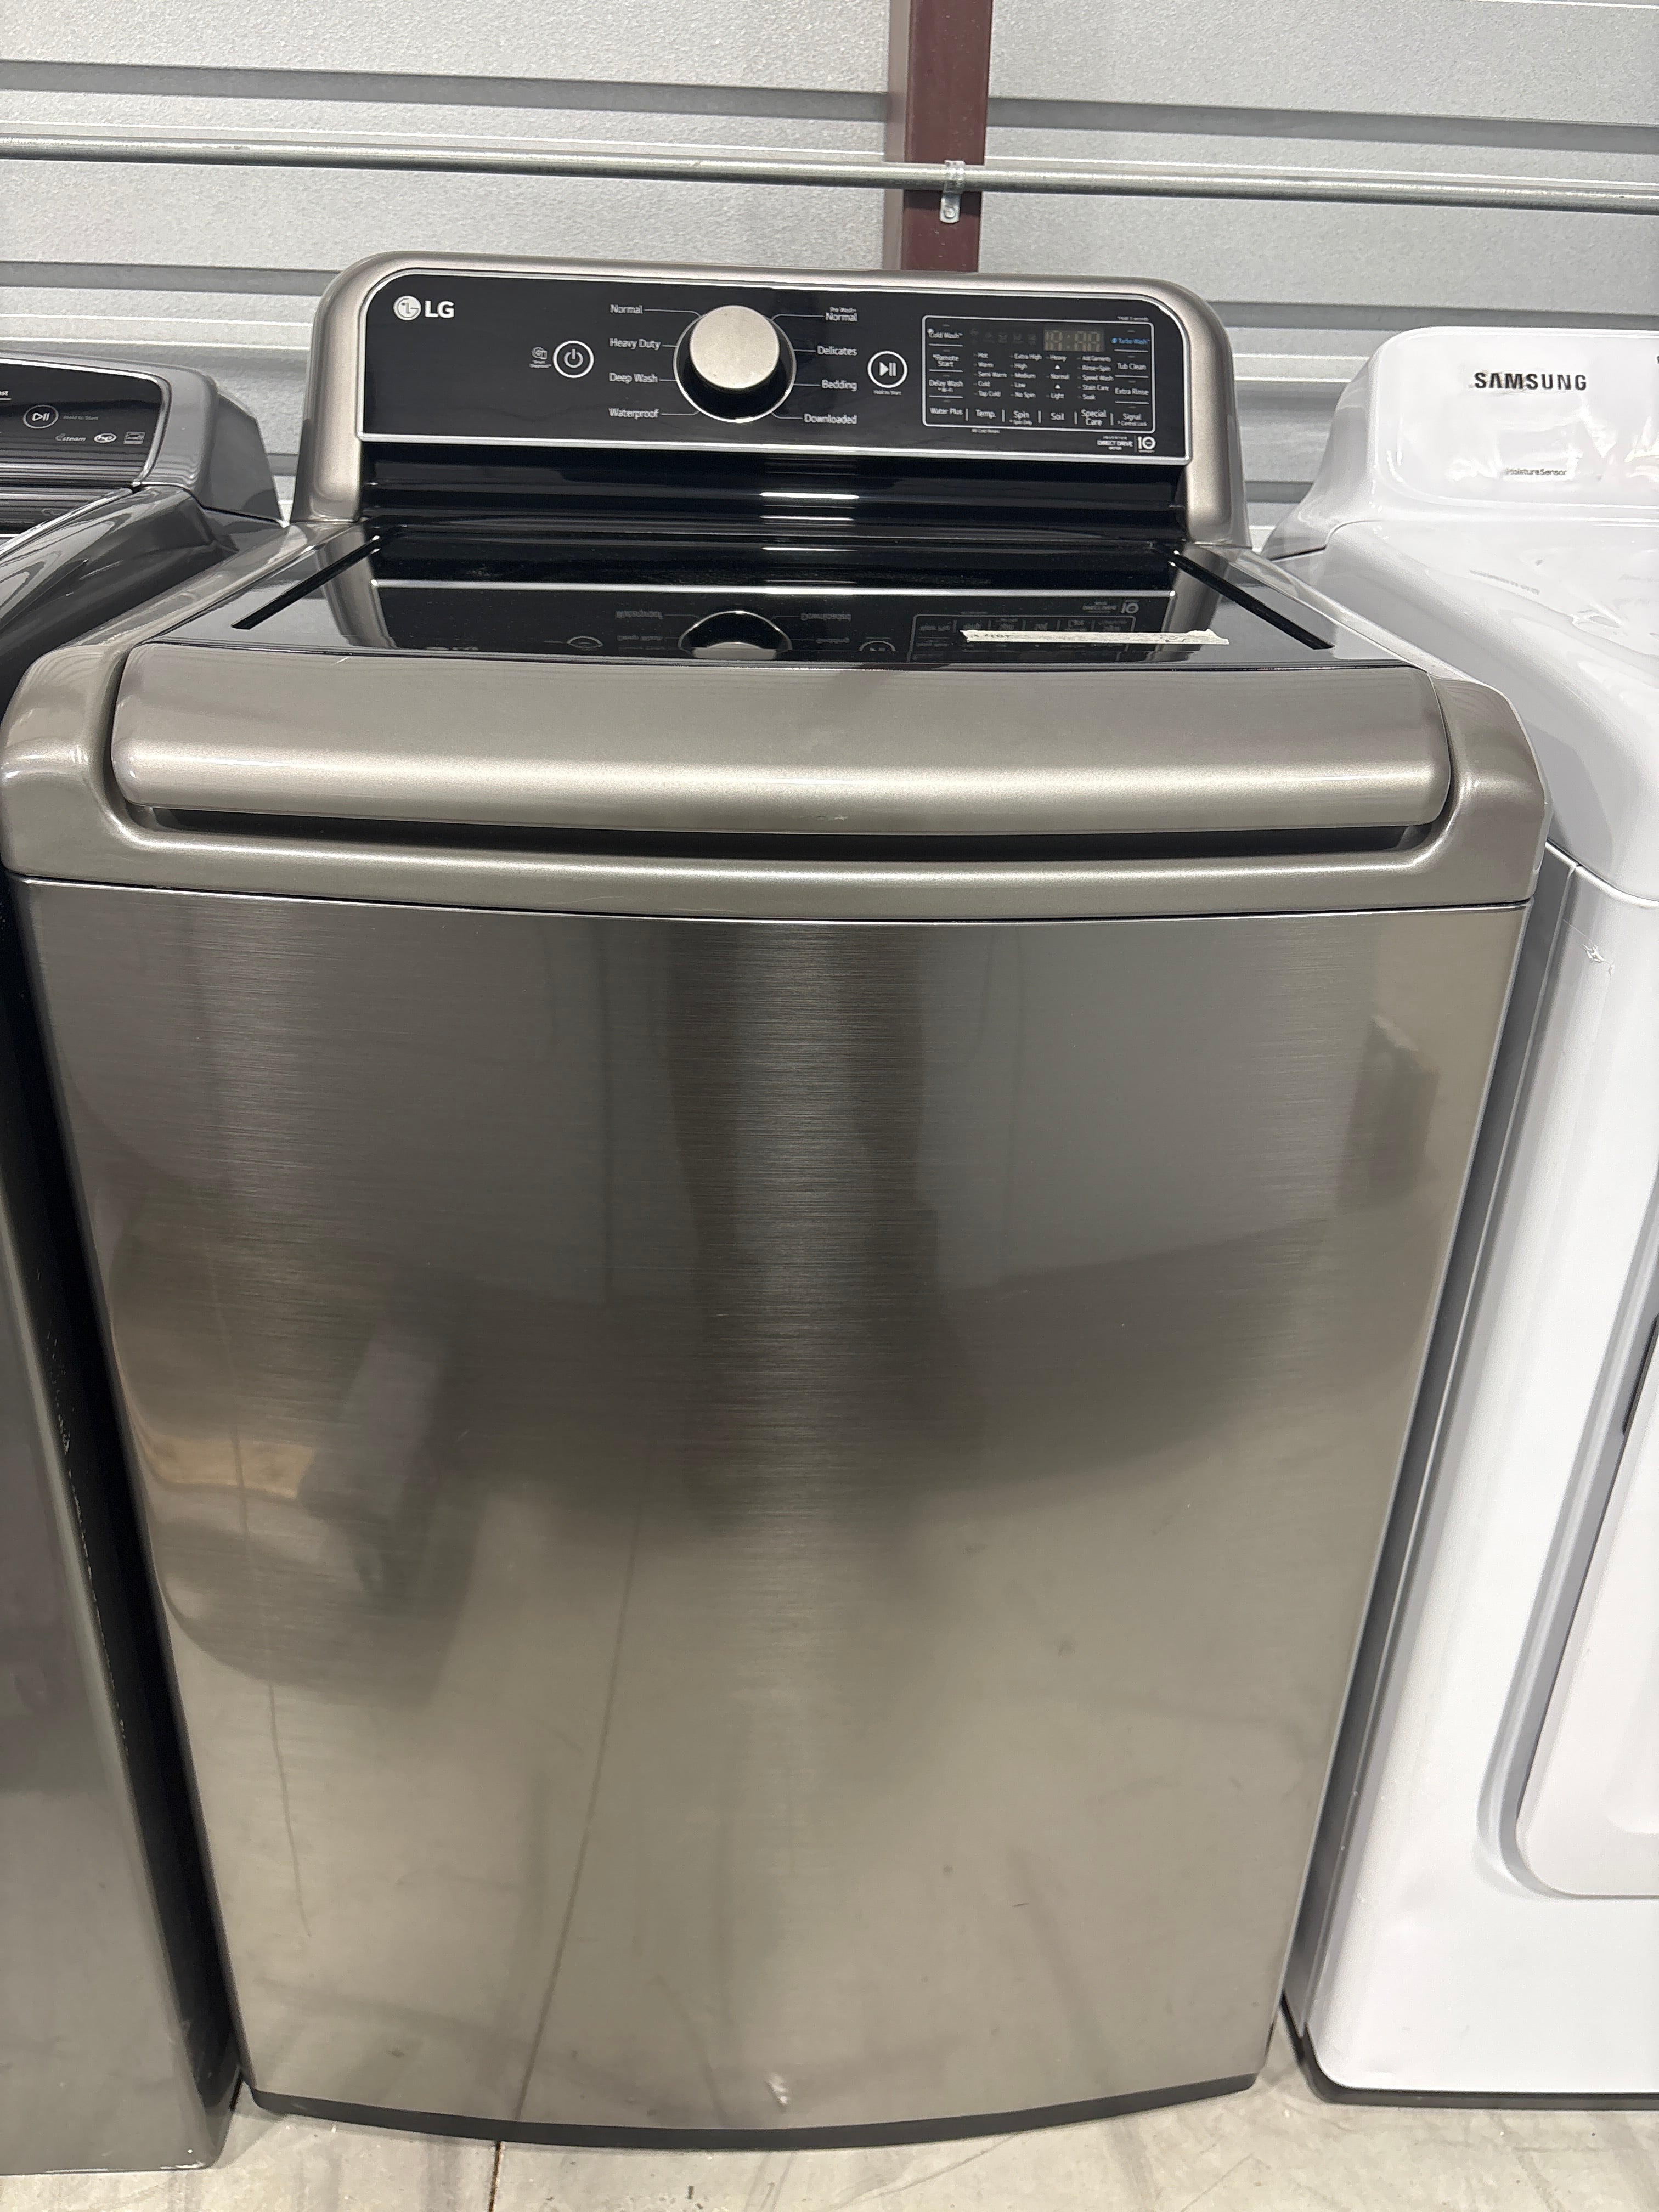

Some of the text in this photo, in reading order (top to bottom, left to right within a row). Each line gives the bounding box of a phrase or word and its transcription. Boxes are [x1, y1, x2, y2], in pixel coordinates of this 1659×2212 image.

[425, 301, 455, 318] LG
[610, 304, 644, 314] Normal
[826, 312, 857, 321] Normal
[609, 338, 661, 350] Heavy Duty
[817, 346, 857, 356] Delicates
[609, 373, 658, 383] Deep Wash
[1474, 372, 1587, 391] SAMSUNG
[822, 380, 857, 392] Bedding
[929, 379, 946, 388] Delay
[609, 408, 660, 420] Waterproof
[804, 414, 857, 424] Downloaded
[1013, 410, 1030, 420] Spin
[1050, 412, 1065, 420] Soil
[1081, 409, 1107, 419] Special
[1122, 413, 1142, 421] Signal
[1085, 417, 1103, 426] Care
